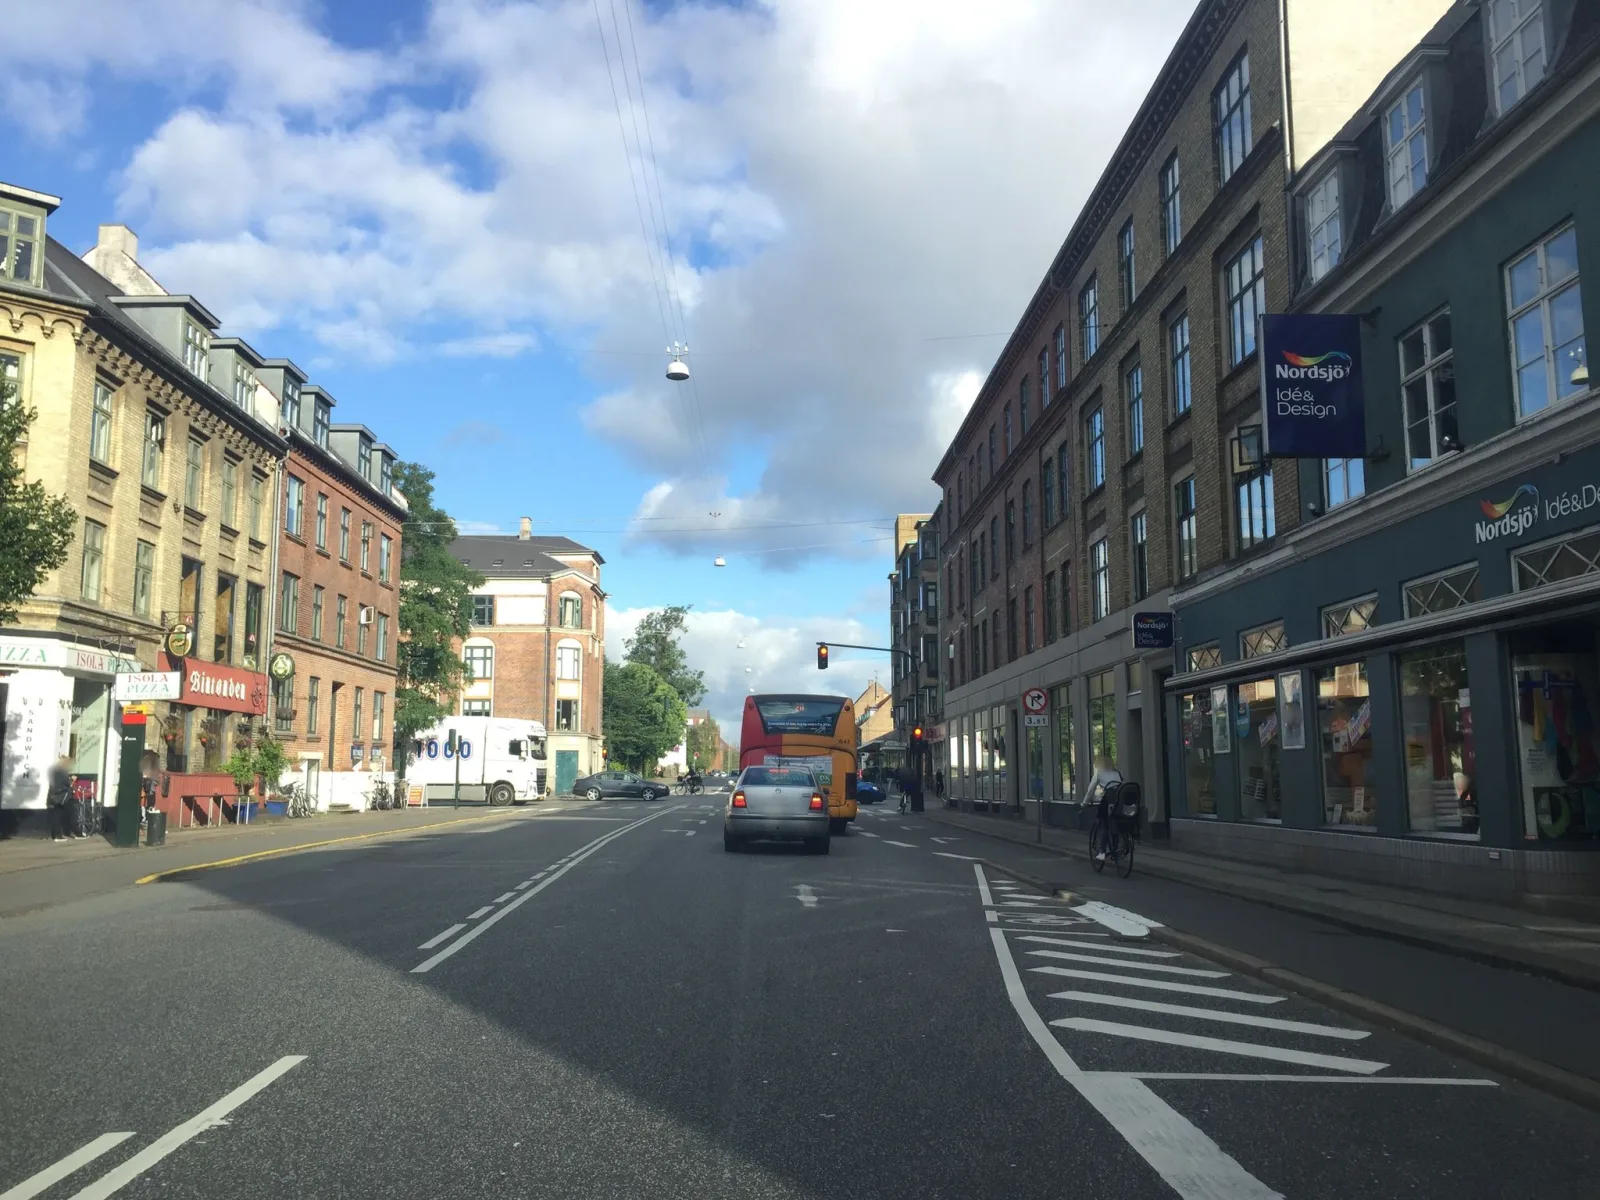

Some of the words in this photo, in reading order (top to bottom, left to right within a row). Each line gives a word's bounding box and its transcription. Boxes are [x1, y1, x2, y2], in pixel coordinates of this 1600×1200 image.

[1275, 363, 1344, 382] Nordsjö
[1276, 386, 1315, 402] Idé&
[1277, 402, 1337, 419] Design
[1474, 505, 1533, 544] Nordsjö
[1137, 621, 1166, 630] Nordsjö
[1137, 637, 1163, 645] Design
[75, 652, 105, 671] ISOLA
[127, 674, 169, 683] ISOLA
[127, 683, 170, 693] PIZZA
